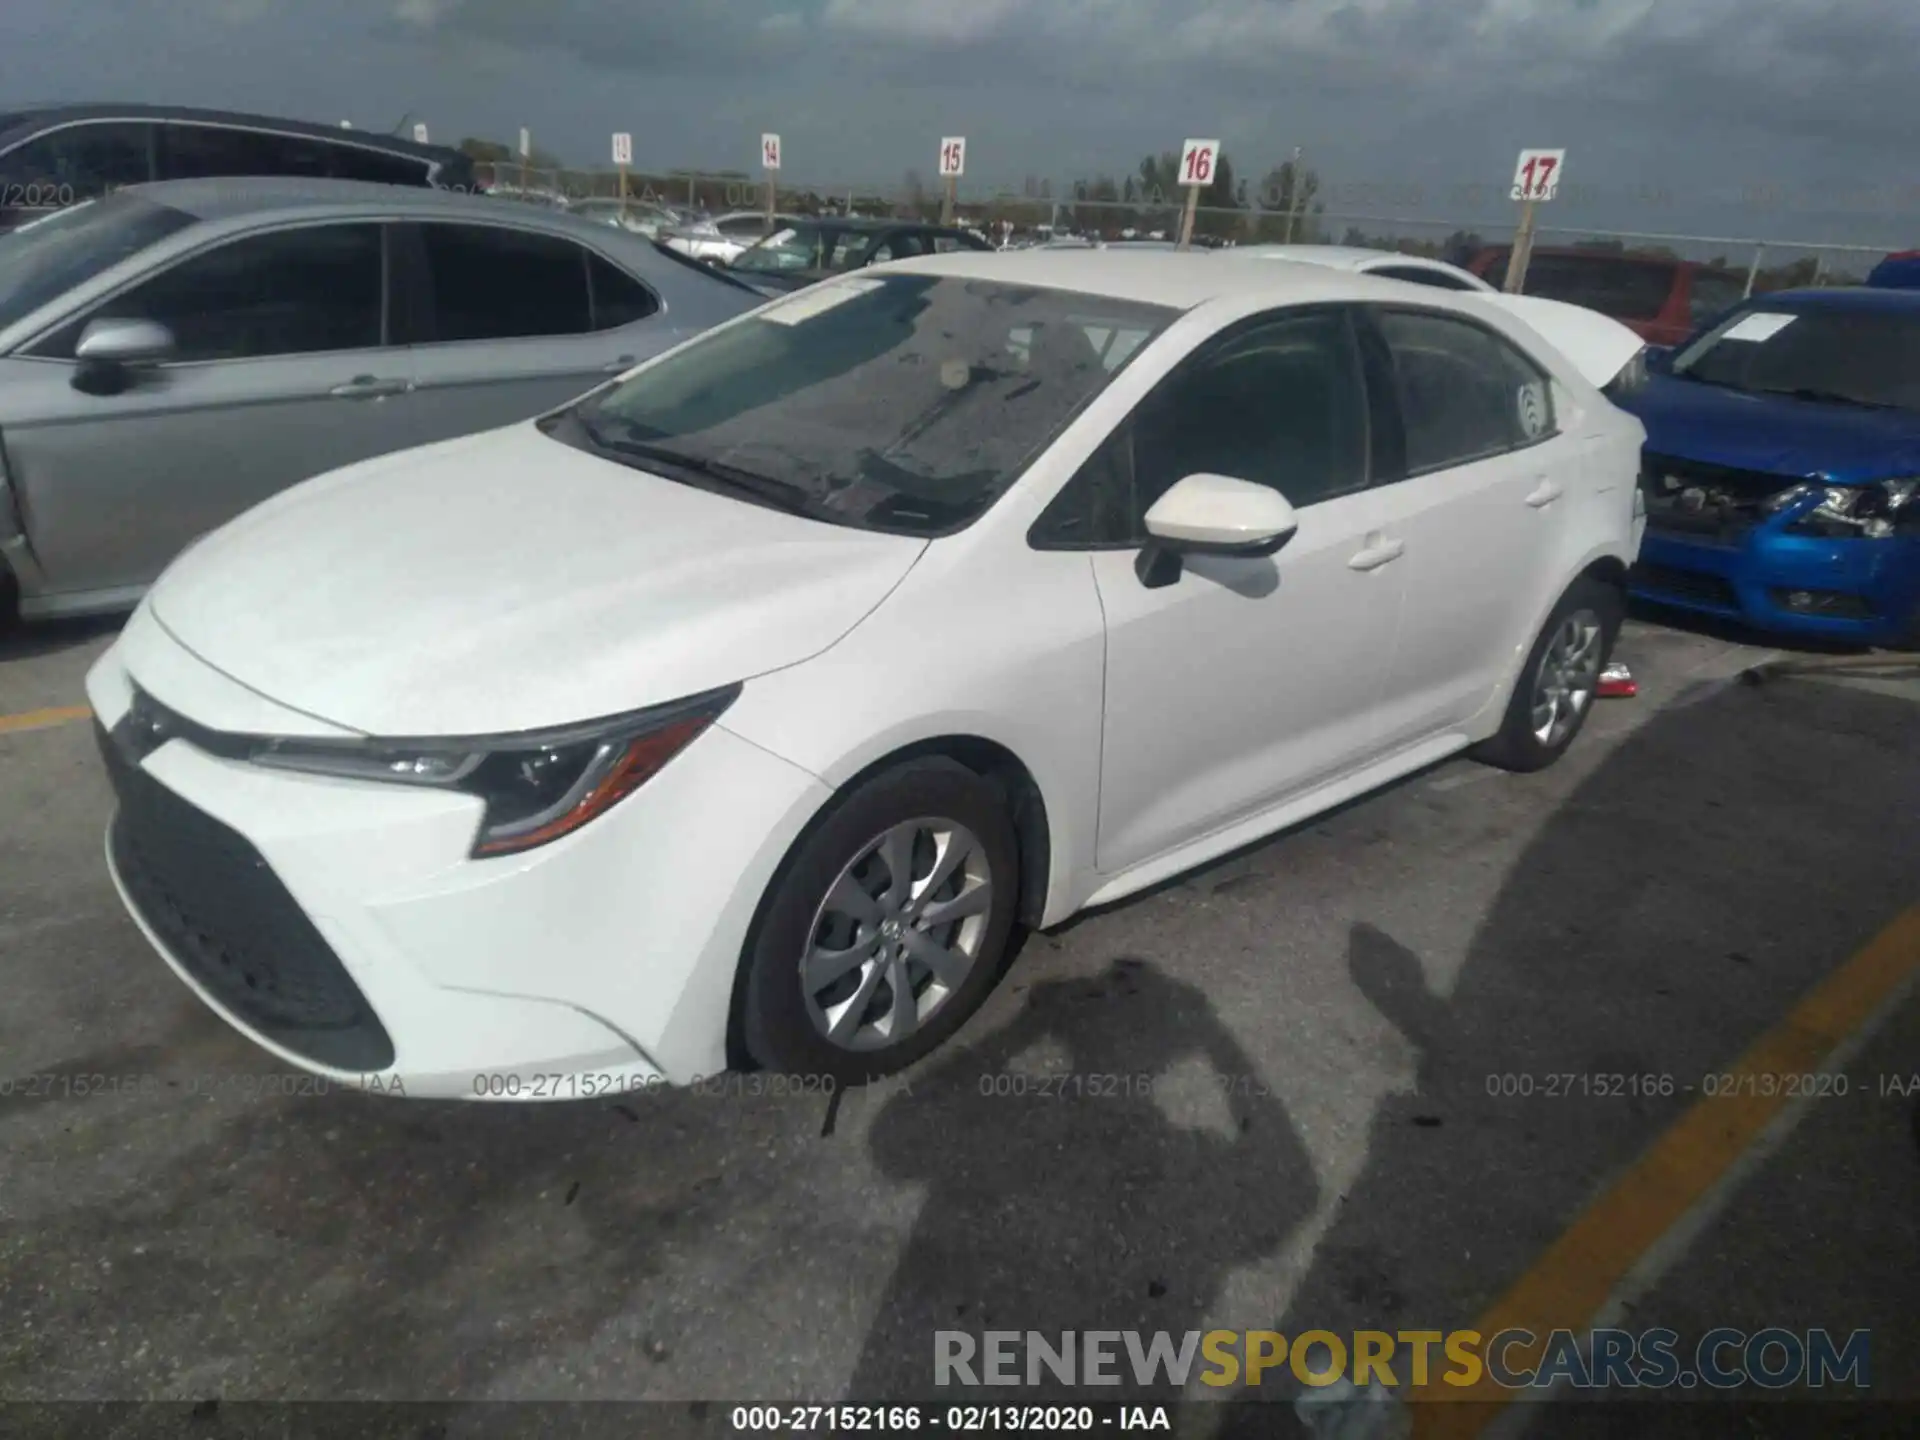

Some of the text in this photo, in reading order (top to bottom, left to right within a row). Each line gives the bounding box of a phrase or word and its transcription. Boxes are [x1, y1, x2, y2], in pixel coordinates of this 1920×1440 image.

[764, 140, 777, 163] 14
[943, 143, 961, 172] 15
[1186, 147, 1211, 180] 16
[1522, 157, 1557, 195] 17
